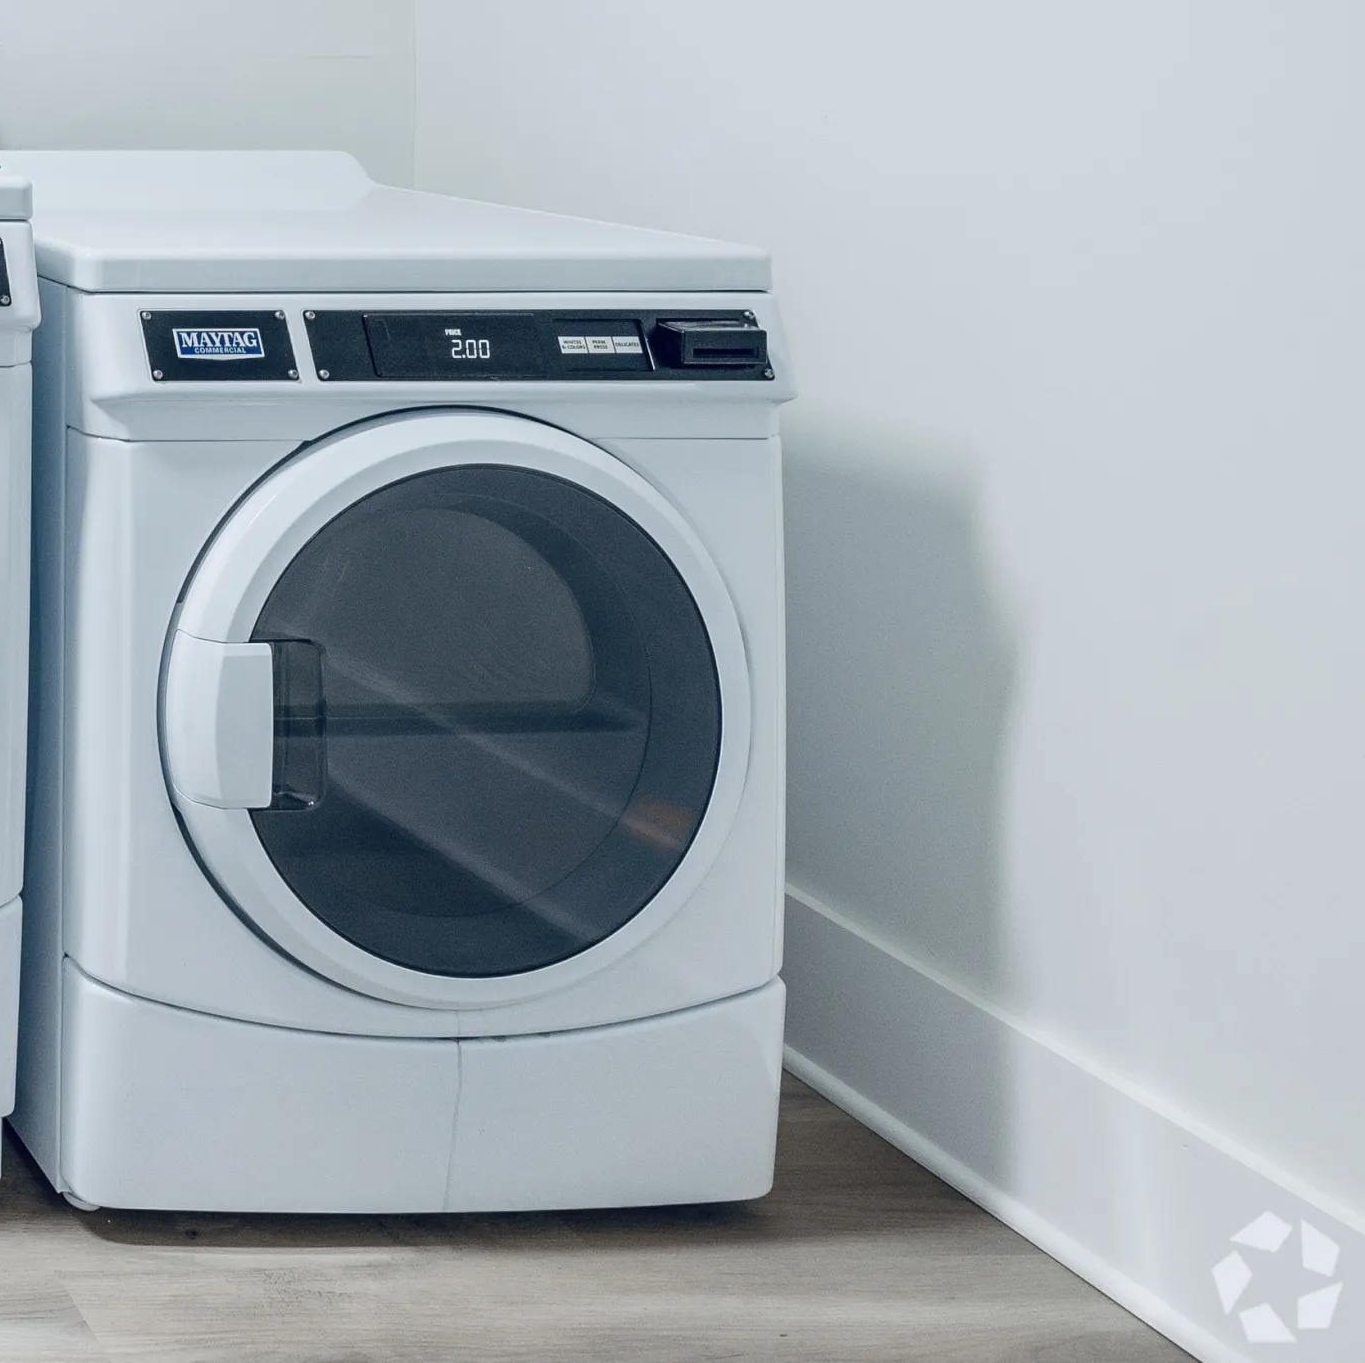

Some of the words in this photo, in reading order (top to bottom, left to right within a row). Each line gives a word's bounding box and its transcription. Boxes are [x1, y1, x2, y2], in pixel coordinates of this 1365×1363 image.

[179, 332, 257, 347] MAYTAG
[444, 328, 461, 336] PRICE
[451, 339, 491, 359] 2.00
